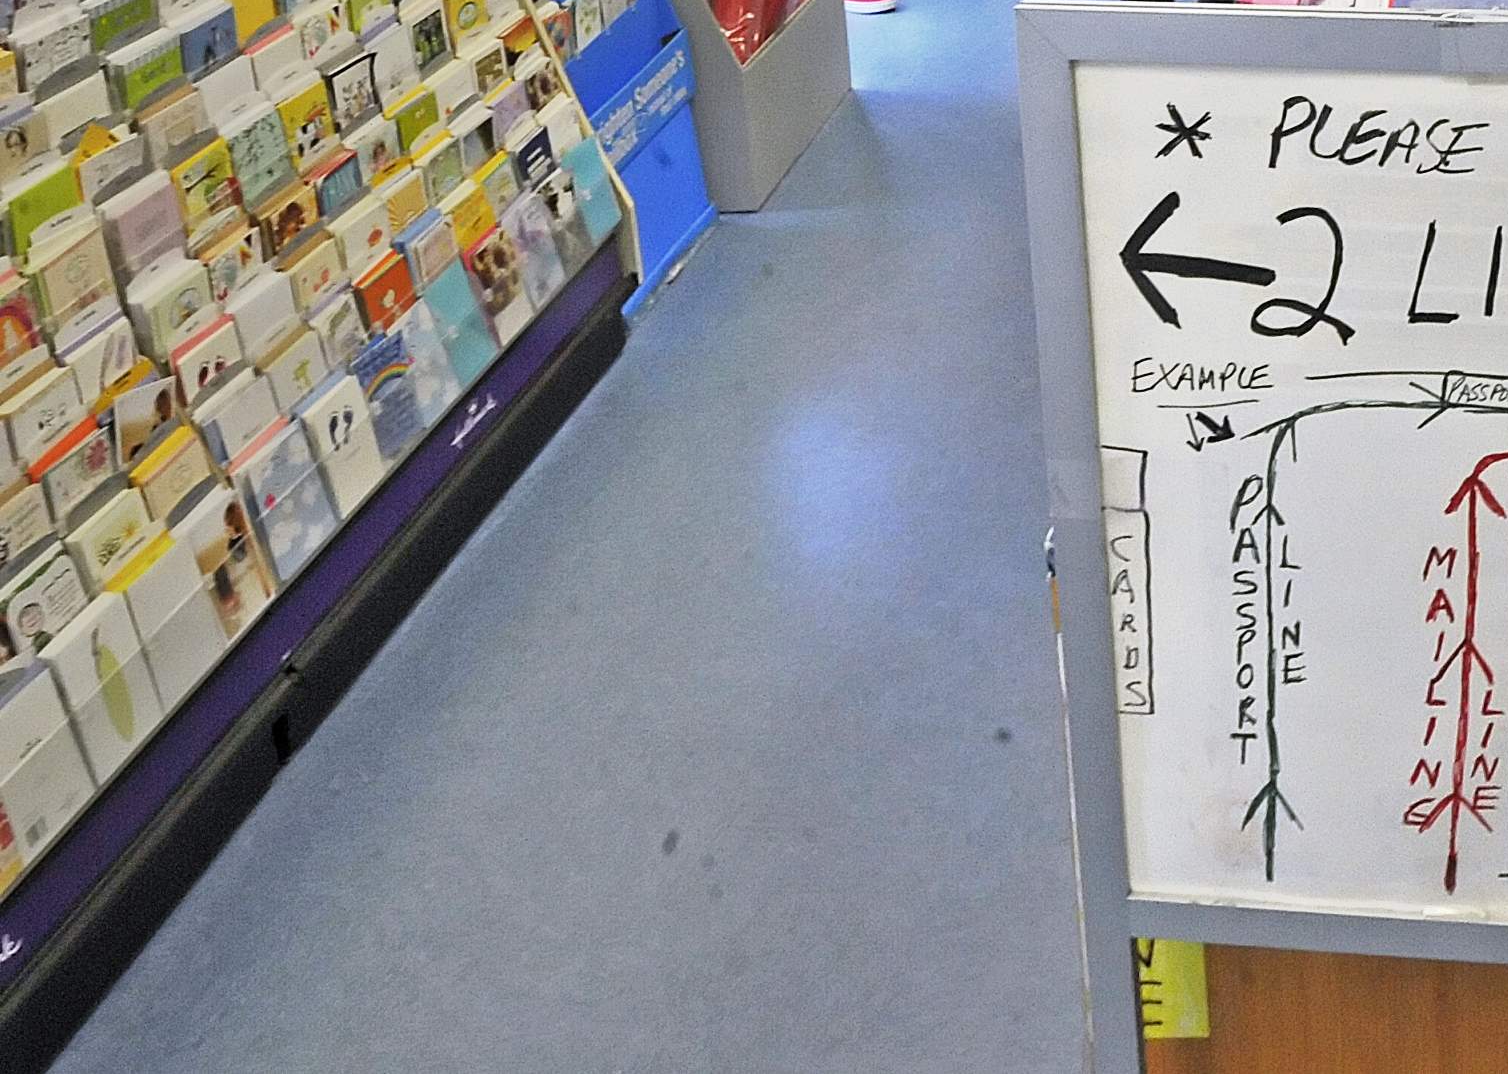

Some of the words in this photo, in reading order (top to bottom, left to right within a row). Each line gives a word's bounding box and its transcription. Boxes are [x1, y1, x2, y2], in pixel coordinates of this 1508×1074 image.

[1269, 95, 1490, 175] PLEASE
[1250, 206, 1356, 346] 2
[1131, 357, 1274, 393] EXAMPLE
[1110, 535, 1147, 707] CARDS
[1230, 474, 1264, 765] PASSPORT
[1279, 534, 1307, 684] LINE
[1403, 546, 1458, 827] MAILING
[1471, 689, 1505, 810] LINE
